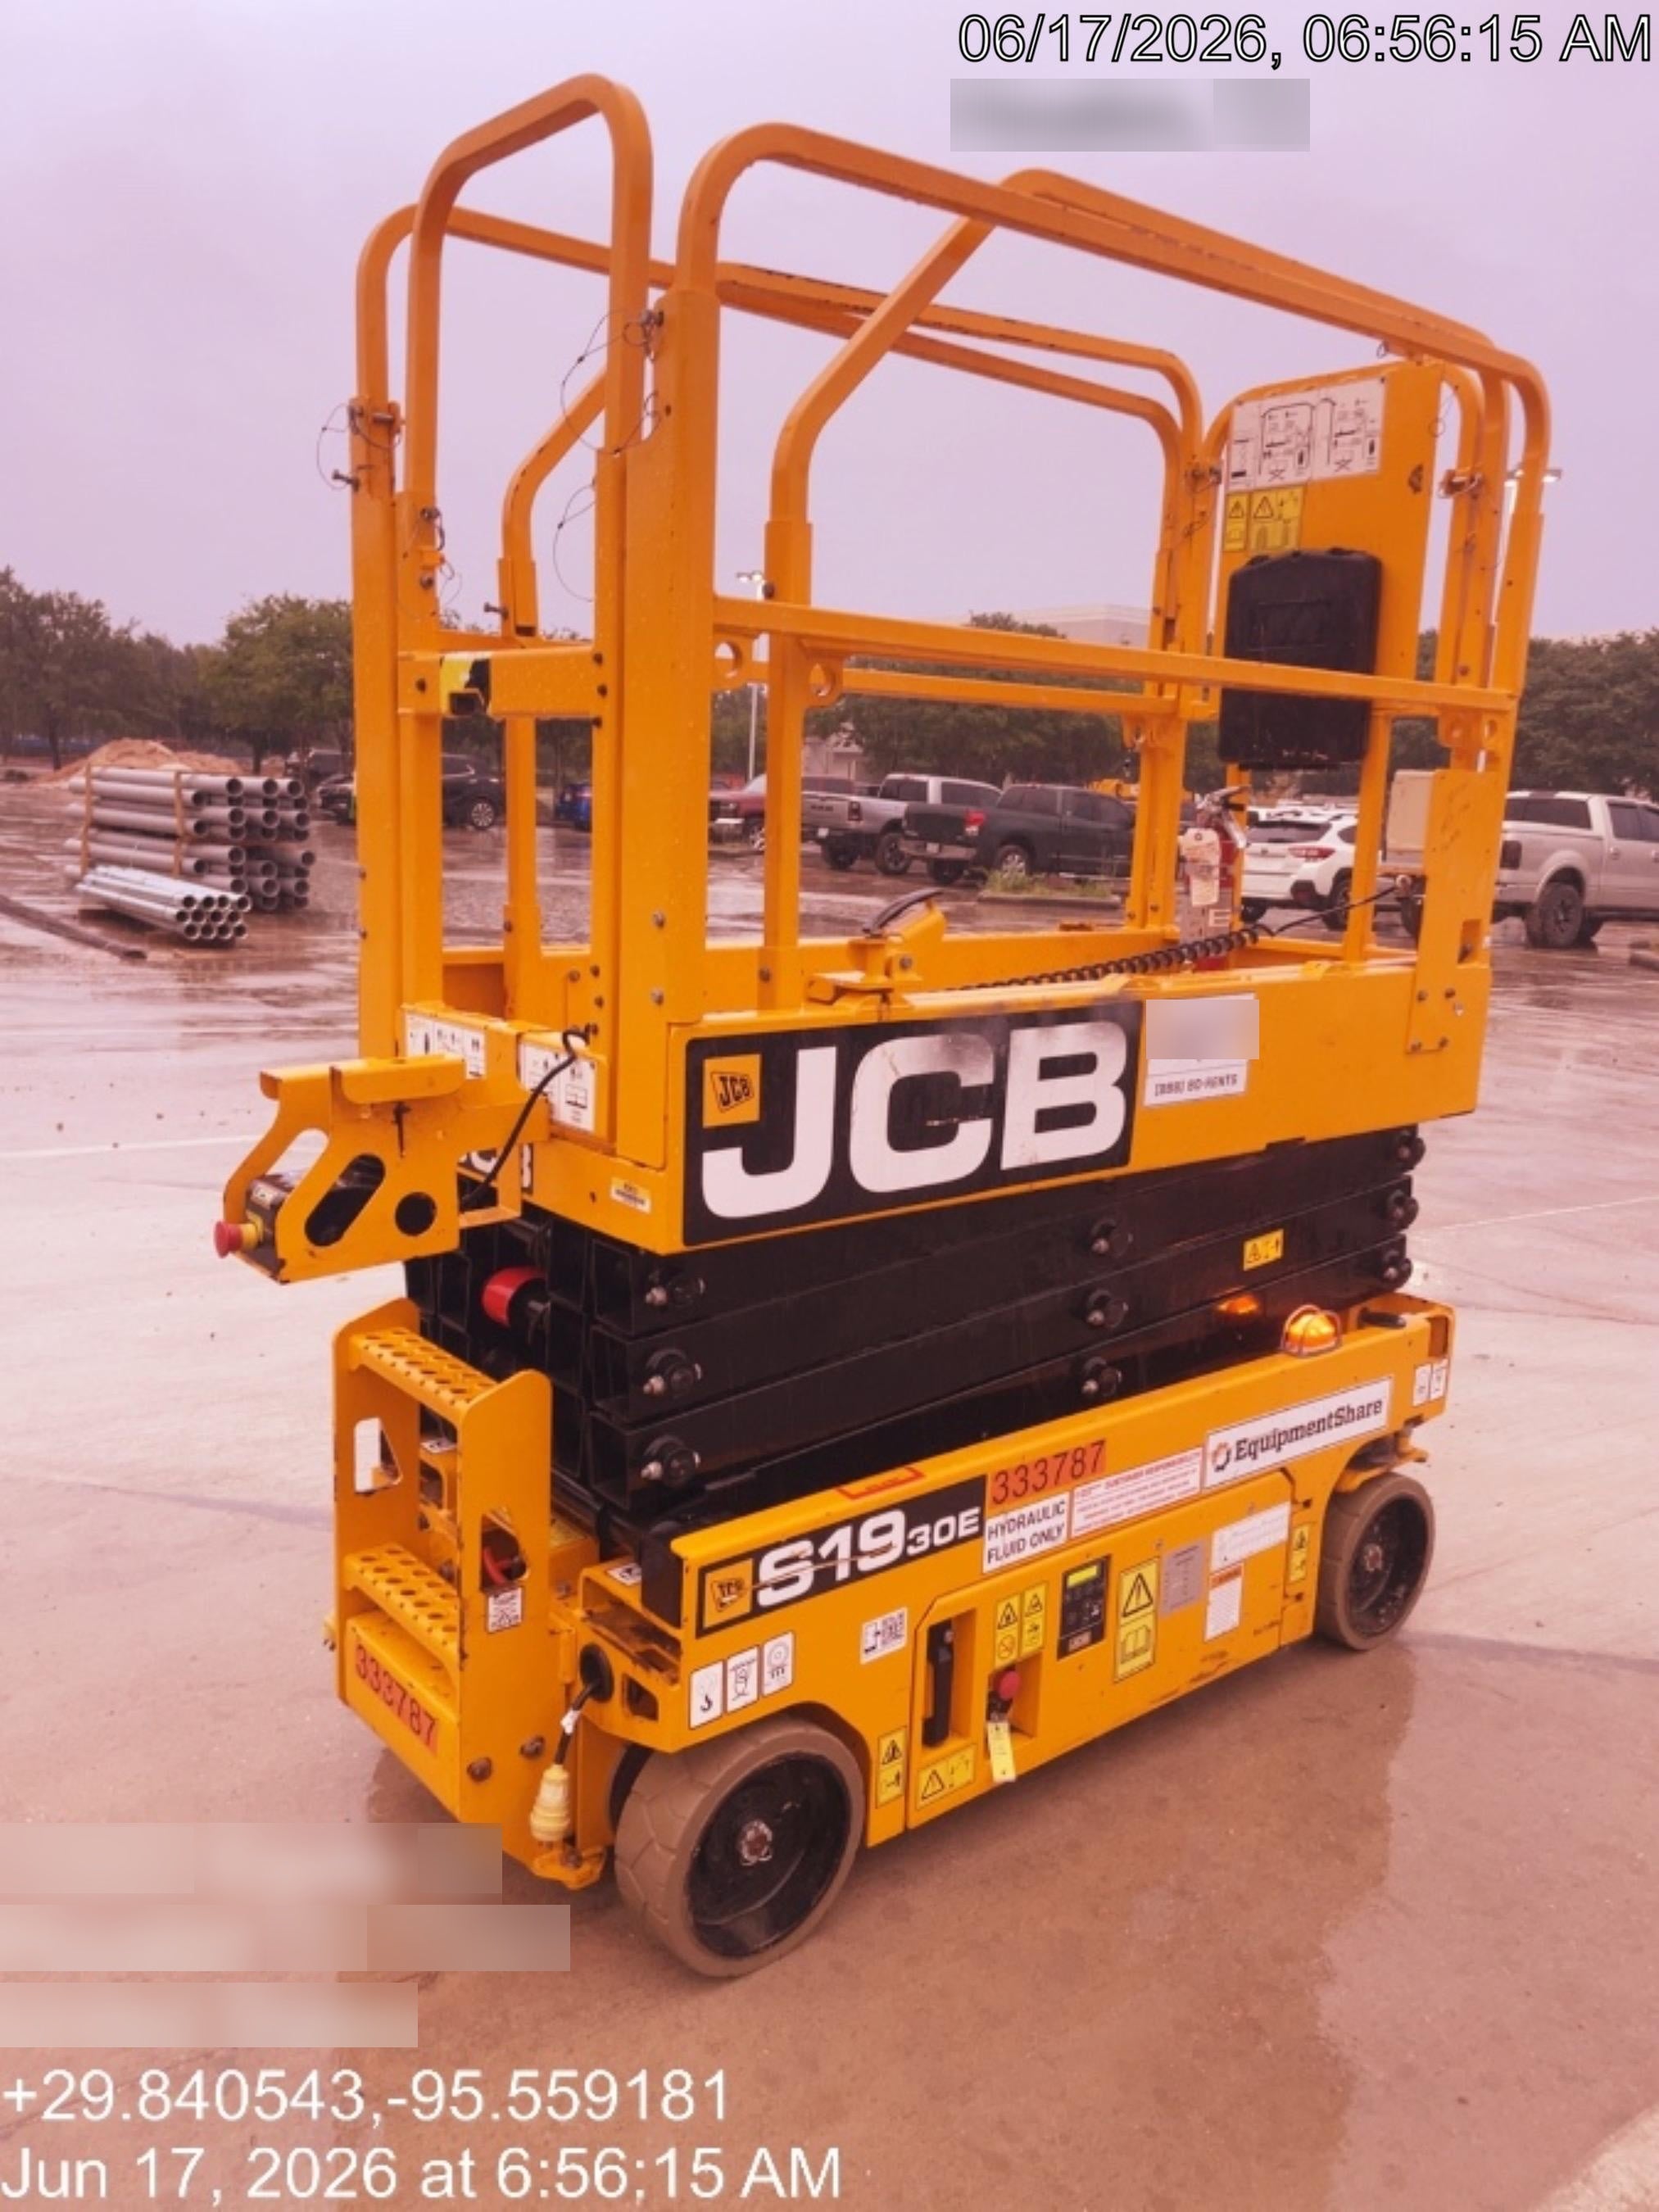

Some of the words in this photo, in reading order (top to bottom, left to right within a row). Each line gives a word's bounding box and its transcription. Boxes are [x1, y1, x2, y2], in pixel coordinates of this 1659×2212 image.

[701, 1021, 1127, 1219] JCB
[718, 1075, 750, 1108] JCB
[1234, 1399, 1383, 1462] EquipmentShare
[991, 1439, 1106, 1505] 333787
[987, 1537, 1027, 1564] FLUID
[1029, 1523, 1064, 1548] ONLY
[988, 1500, 1066, 1542] HYDRAULIC
[356, 1643, 436, 1747] 333787
